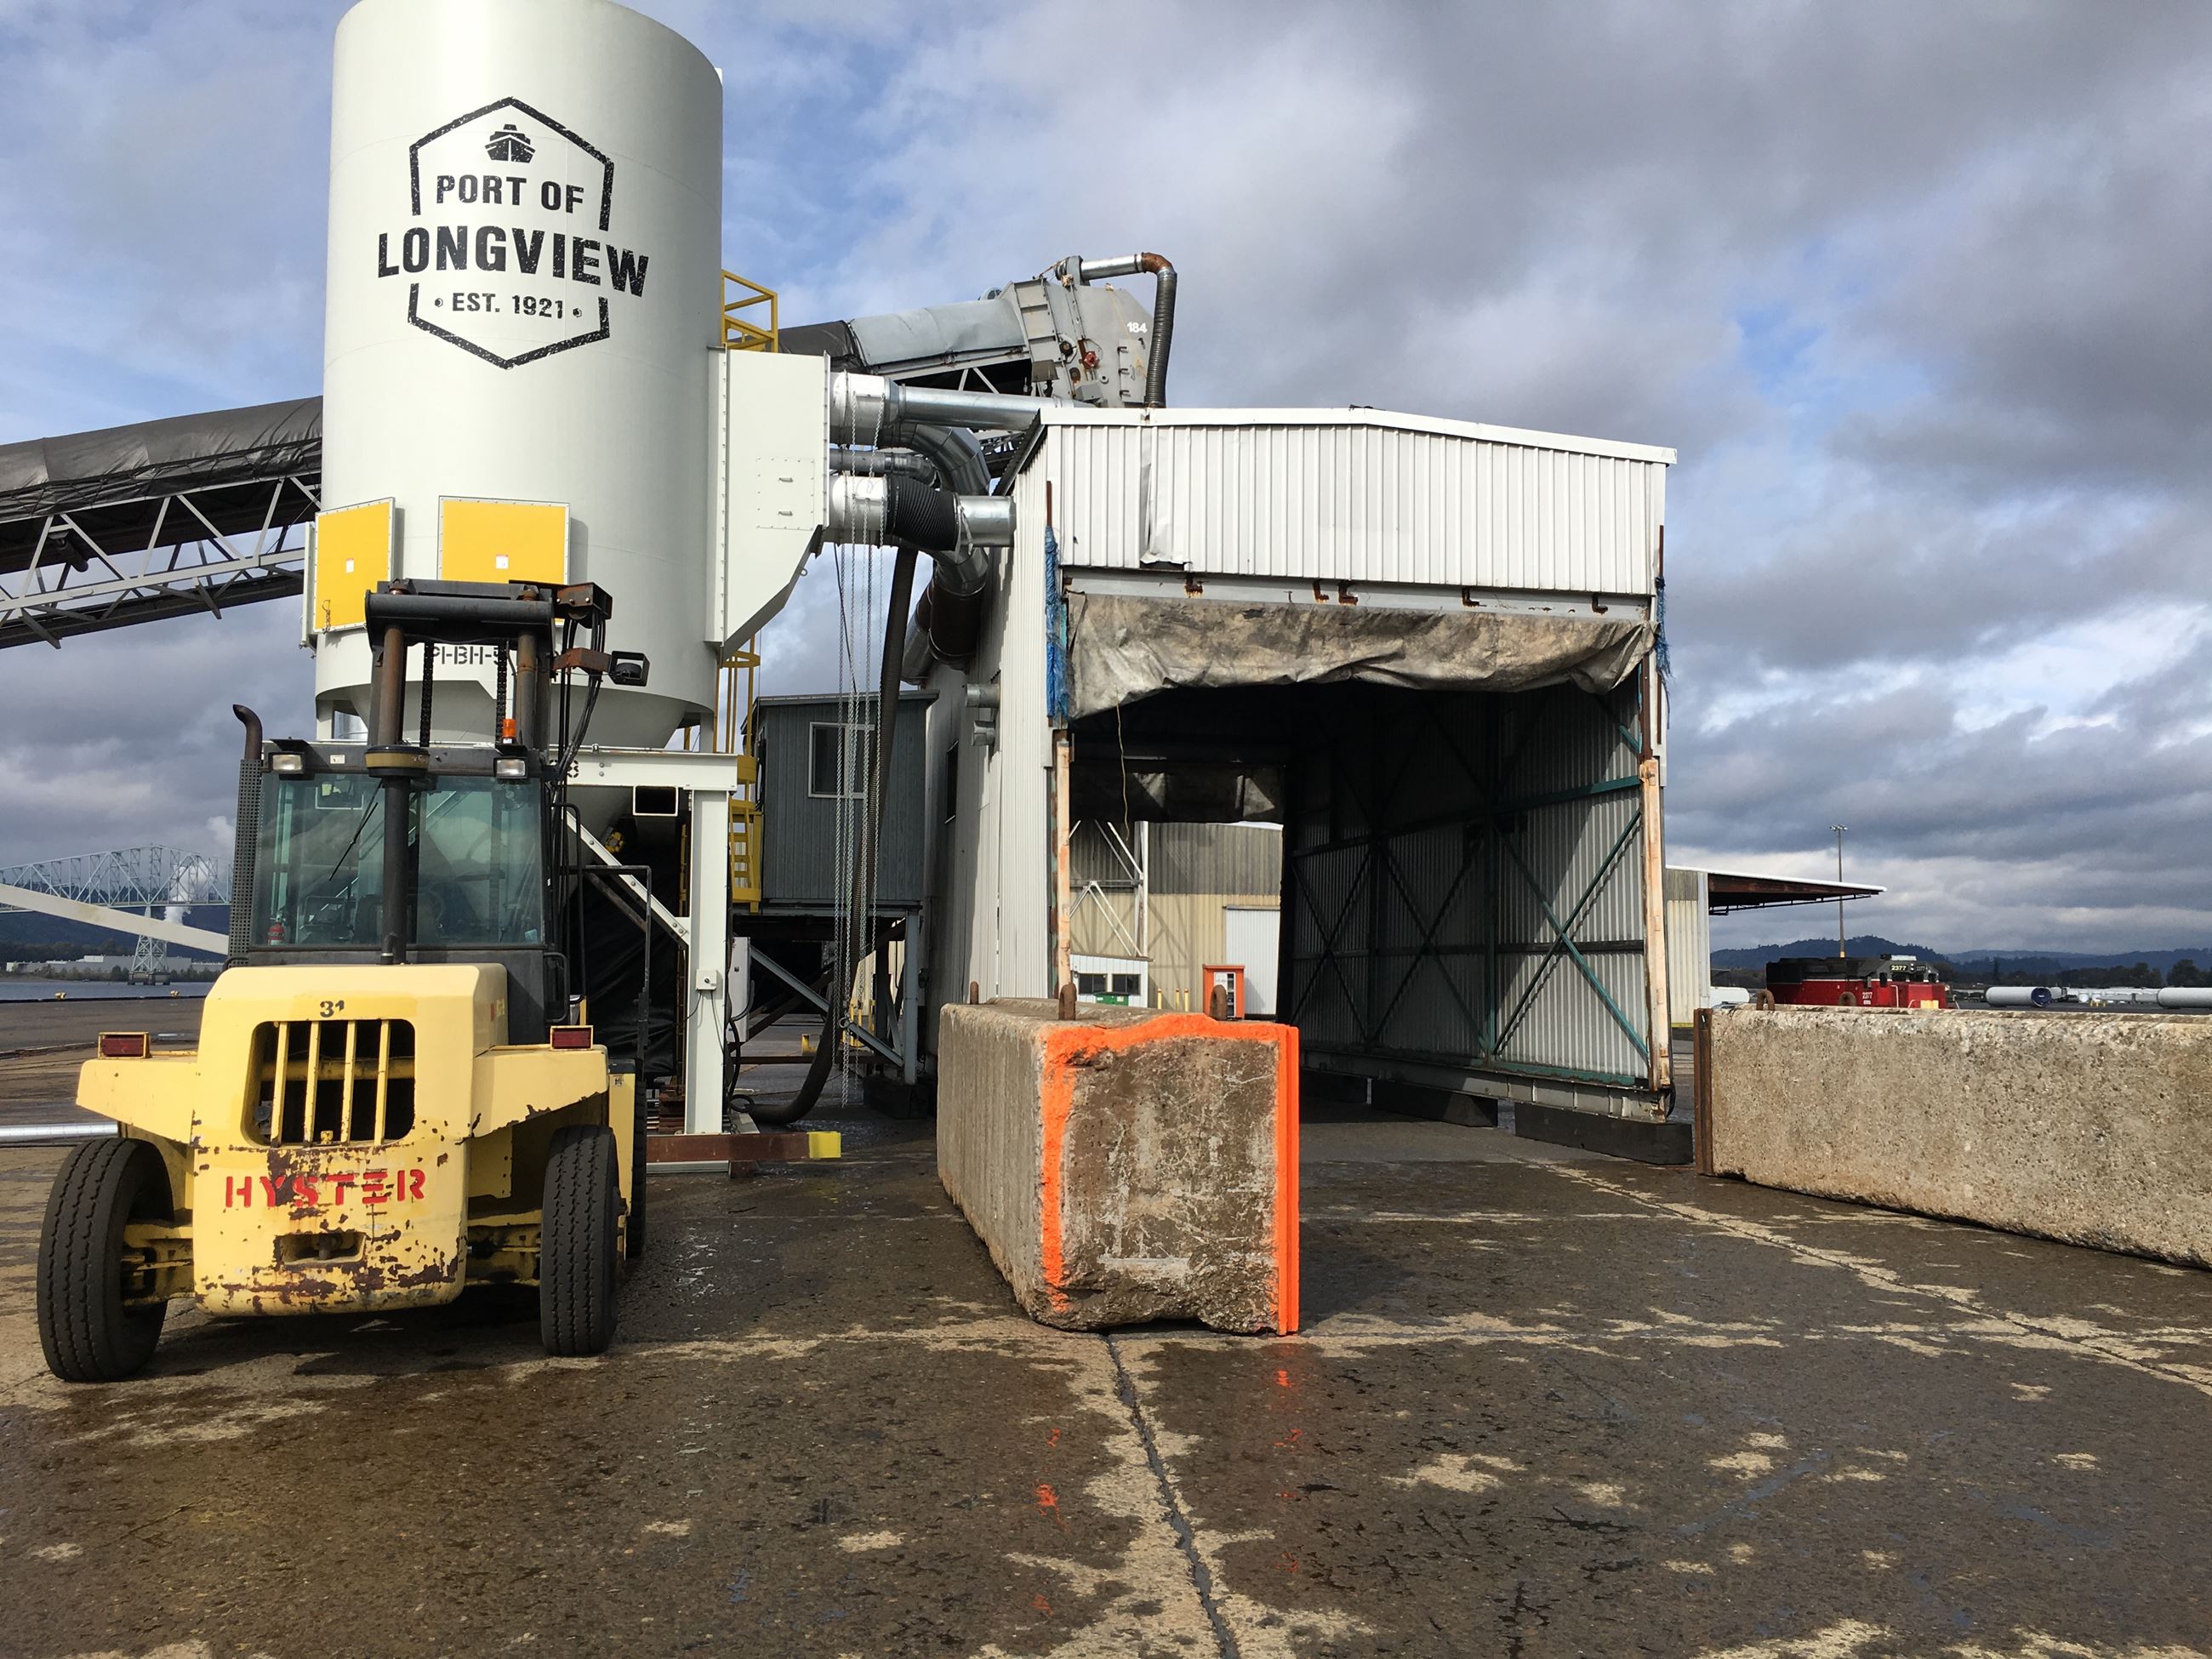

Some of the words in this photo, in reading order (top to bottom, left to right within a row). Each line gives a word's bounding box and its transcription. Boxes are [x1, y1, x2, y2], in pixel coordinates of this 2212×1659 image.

[436, 174, 527, 206] PORT
[540, 180, 584, 214] OF
[378, 225, 649, 298] LONGVIEW
[452, 292, 500, 313] EST.
[511, 294, 563, 319] 1921
[1126, 322, 1148, 334] 184
[225, 1168, 426, 1208] HYSTER
